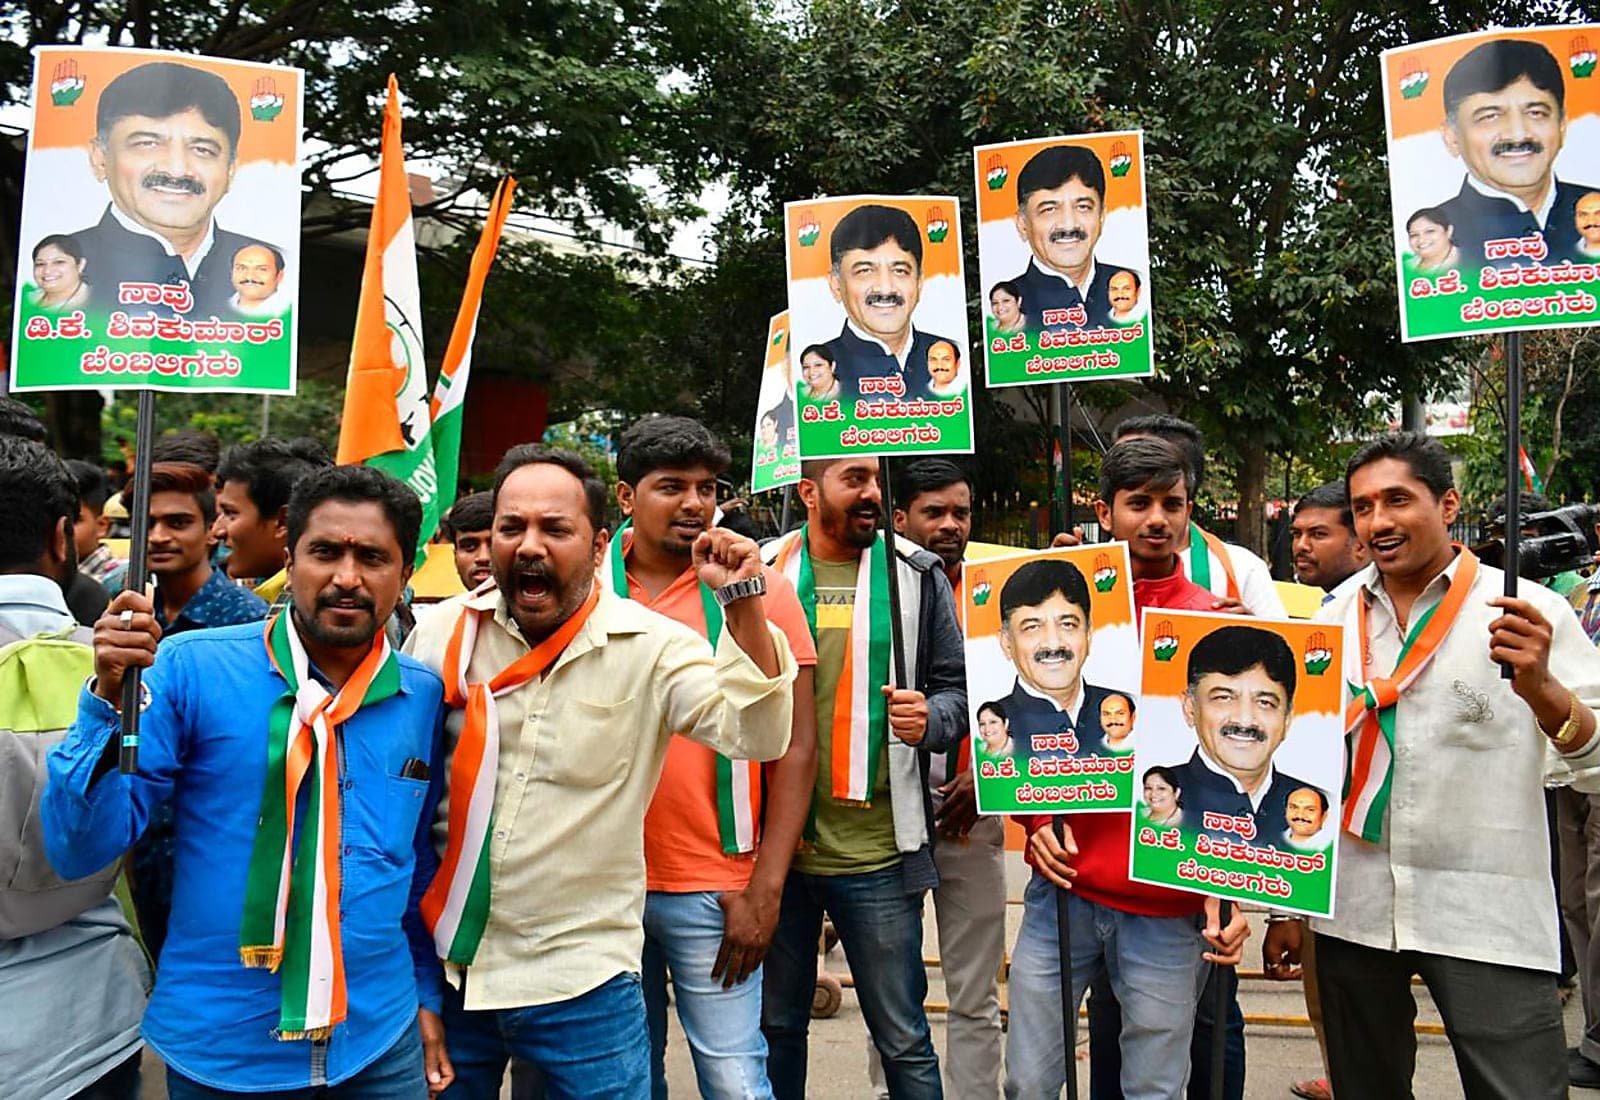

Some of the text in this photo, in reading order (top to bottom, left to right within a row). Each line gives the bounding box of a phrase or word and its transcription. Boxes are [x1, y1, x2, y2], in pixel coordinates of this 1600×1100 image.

[1486, 232, 1547, 259] ನಾವು
[120, 281, 193, 311] ನಾವು
[1411, 271, 1466, 297] ಡಿ.ಕೆ.
[1043, 304, 1087, 325] ನಾವು
[1463, 290, 1595, 322] ಬೆಂಬಲಿಗರು
[27, 312, 282, 343] ಡಿ.ಕೆ. ಶಿವಕುಮಾರ್
[992, 324, 1143, 352] ಡಿ.ಕೆ. ಶಿವಕುಮಾರ್
[82, 347, 240, 375] ಬೆಂಬಲಿಗರು
[1027, 350, 1119, 374] ಬೆಂಬಲಿಗರು
[860, 373, 906, 395] ನಾವು
[803, 397, 963, 422] ಡಿ.ಕೆ. ಶಿವಕುಮಾರ್
[842, 423, 939, 446] ಬೆಂಬಲಿಗರು
[1031, 730, 1079, 753] ನಾವು
[981, 758, 1019, 778] ಡಿ.ಕೆ.
[1016, 780, 1117, 803] ಬೆಂಬಲಿಗರು
[1204, 811, 1257, 839] ನಾವು
[1139, 828, 1325, 872] ಡಿ.ಕೆ. ಶಿವಕುಮಾರ್
[1178, 858, 1291, 897] ಬೆಂಬಲಿಗರು
